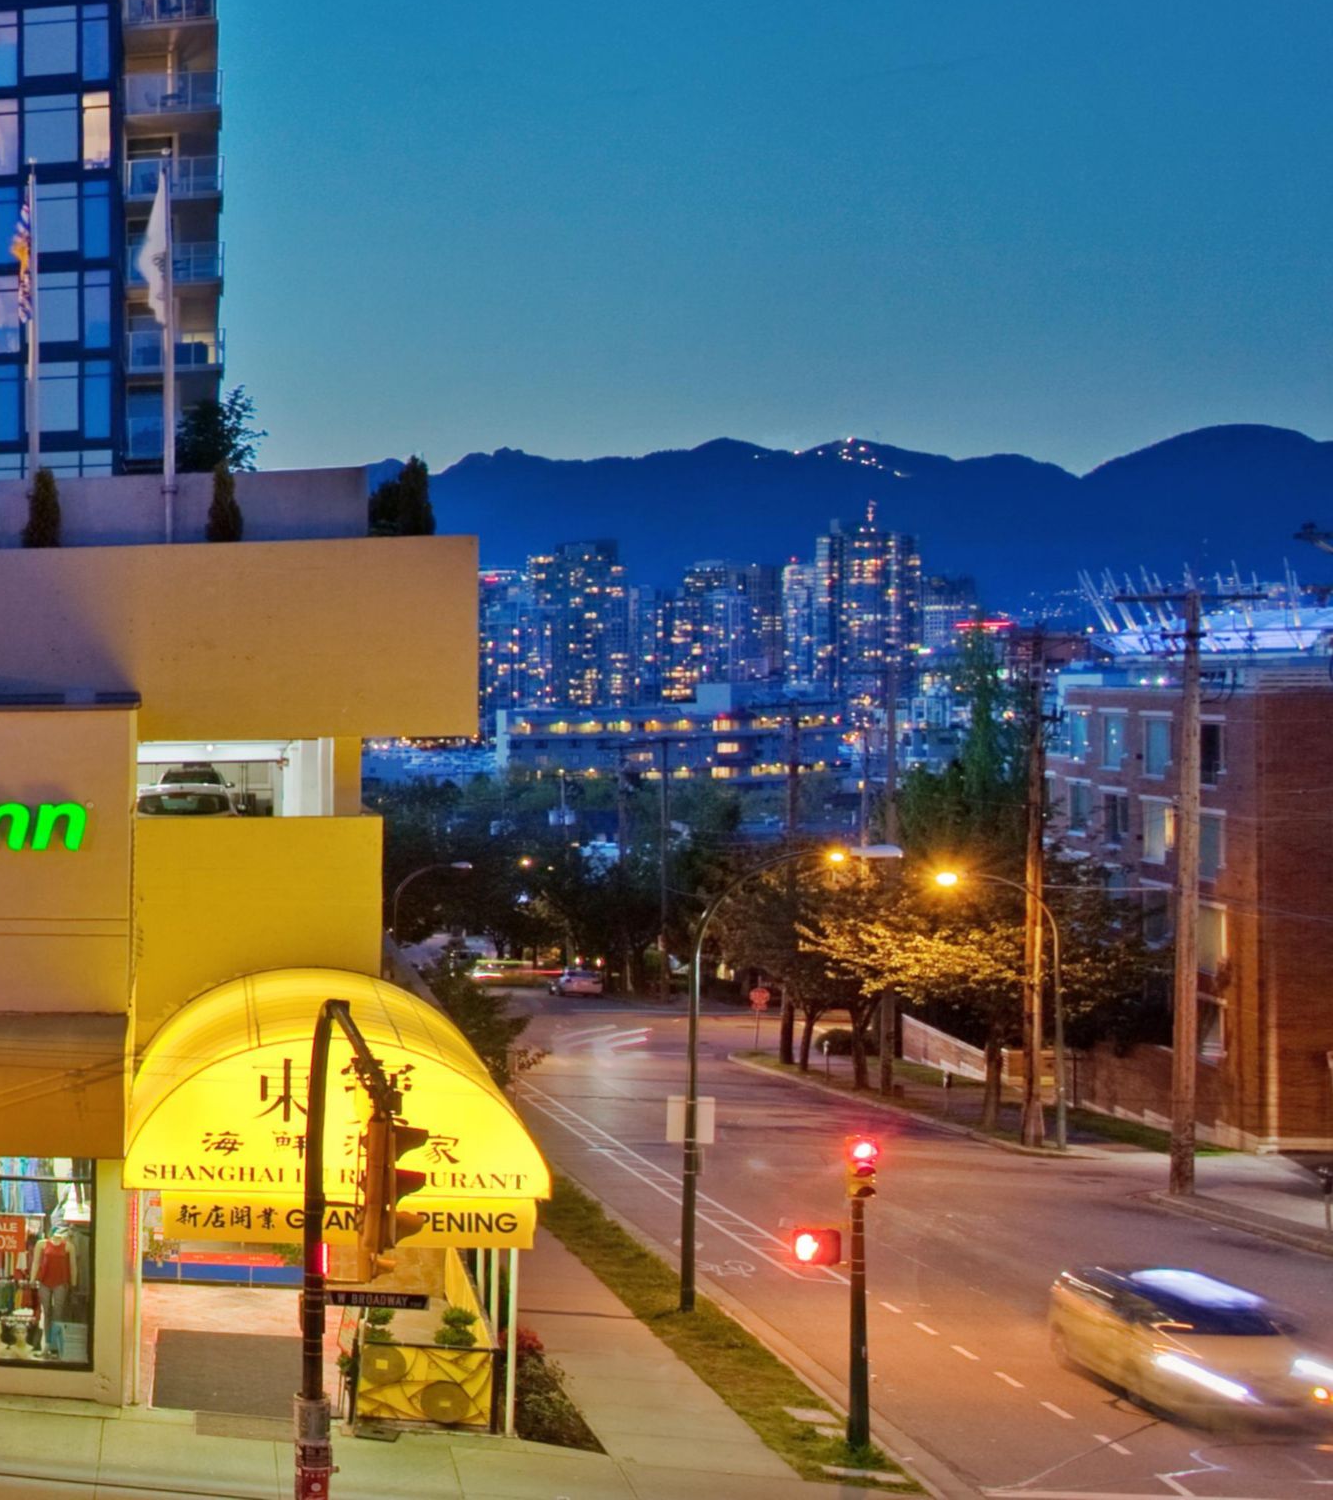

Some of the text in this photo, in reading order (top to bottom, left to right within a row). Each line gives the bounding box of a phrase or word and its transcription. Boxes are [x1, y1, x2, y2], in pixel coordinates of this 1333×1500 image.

[143, 1164, 285, 1183] SHANGHAI
[340, 1168, 528, 1190] RURANT
[285, 1208, 518, 1234] GAN PENING
[337, 1293, 346, 1304] W
[351, 1294, 410, 1307] BROADWAY
